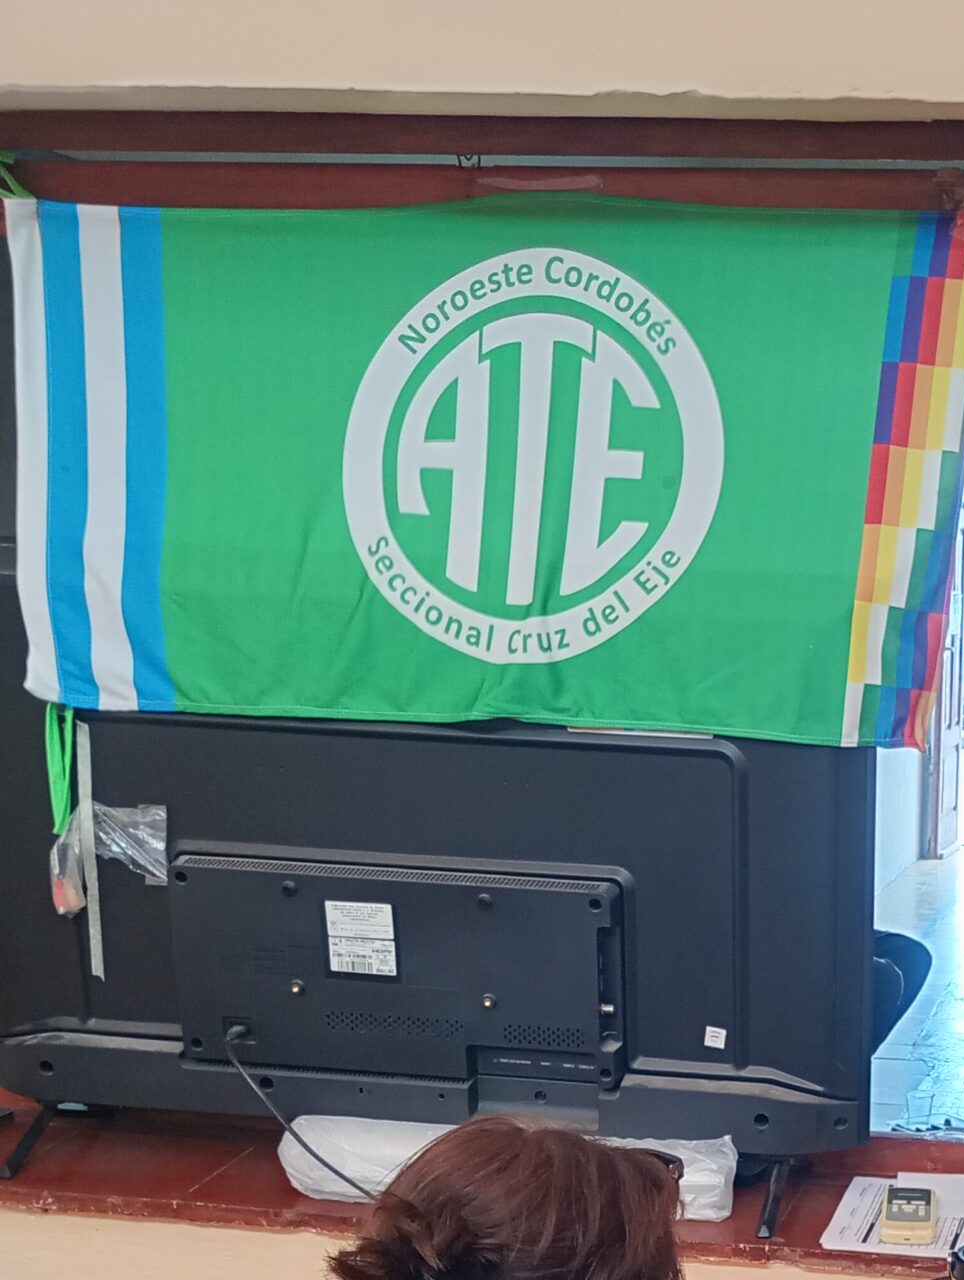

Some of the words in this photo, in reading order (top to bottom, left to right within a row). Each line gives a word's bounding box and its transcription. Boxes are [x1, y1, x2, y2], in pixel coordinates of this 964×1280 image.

[398, 263, 534, 354] Noroeste
[544, 256, 677, 356] Cordobés
[397, 313, 661, 605] ATE
[367, 536, 494, 652] Seccional
[507, 628, 570, 654] Cruz
[582, 591, 630, 637] del
[634, 549, 681, 596] Eje
